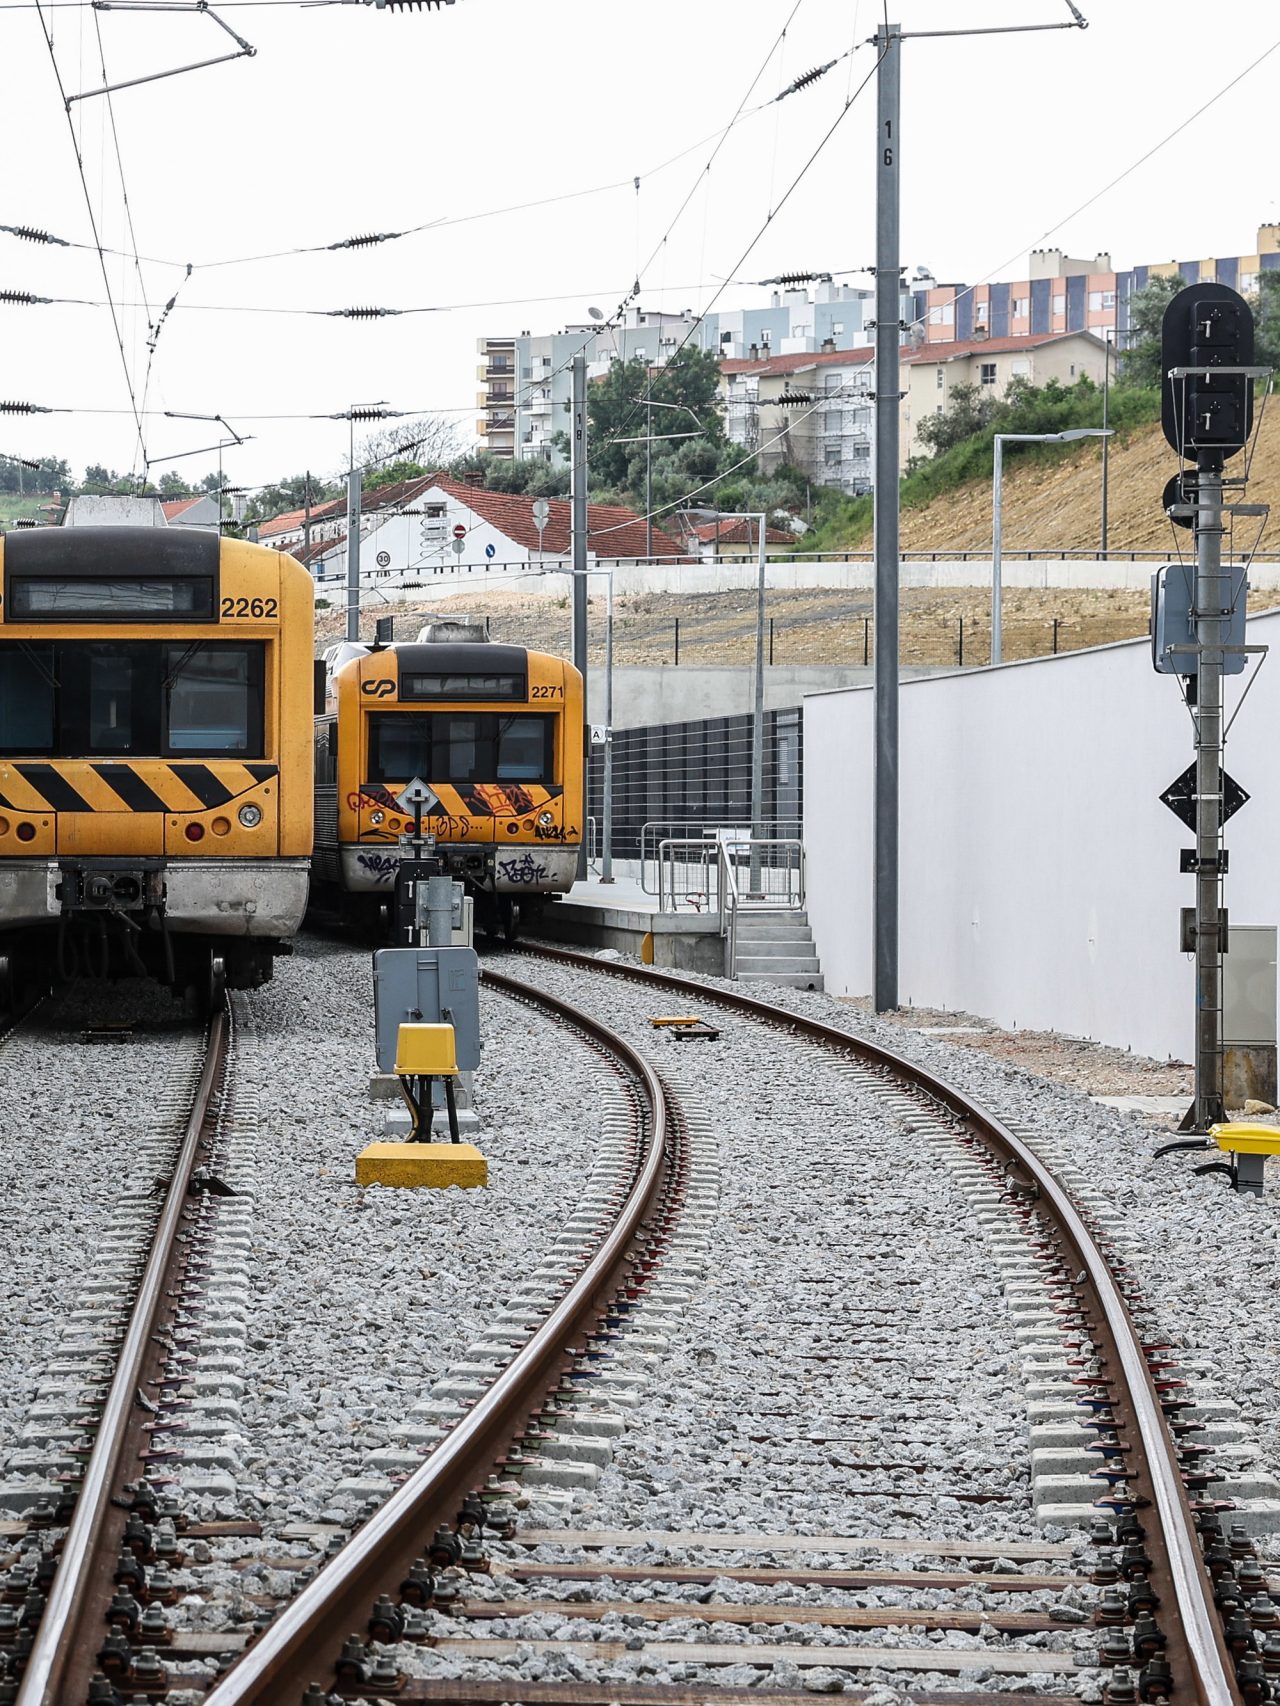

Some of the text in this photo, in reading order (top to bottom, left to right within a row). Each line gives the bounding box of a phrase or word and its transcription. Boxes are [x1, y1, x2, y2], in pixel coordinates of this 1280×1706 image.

[221, 597, 278, 618] 2262
[361, 679, 396, 698] CP
[531, 686, 563, 698] 2271
